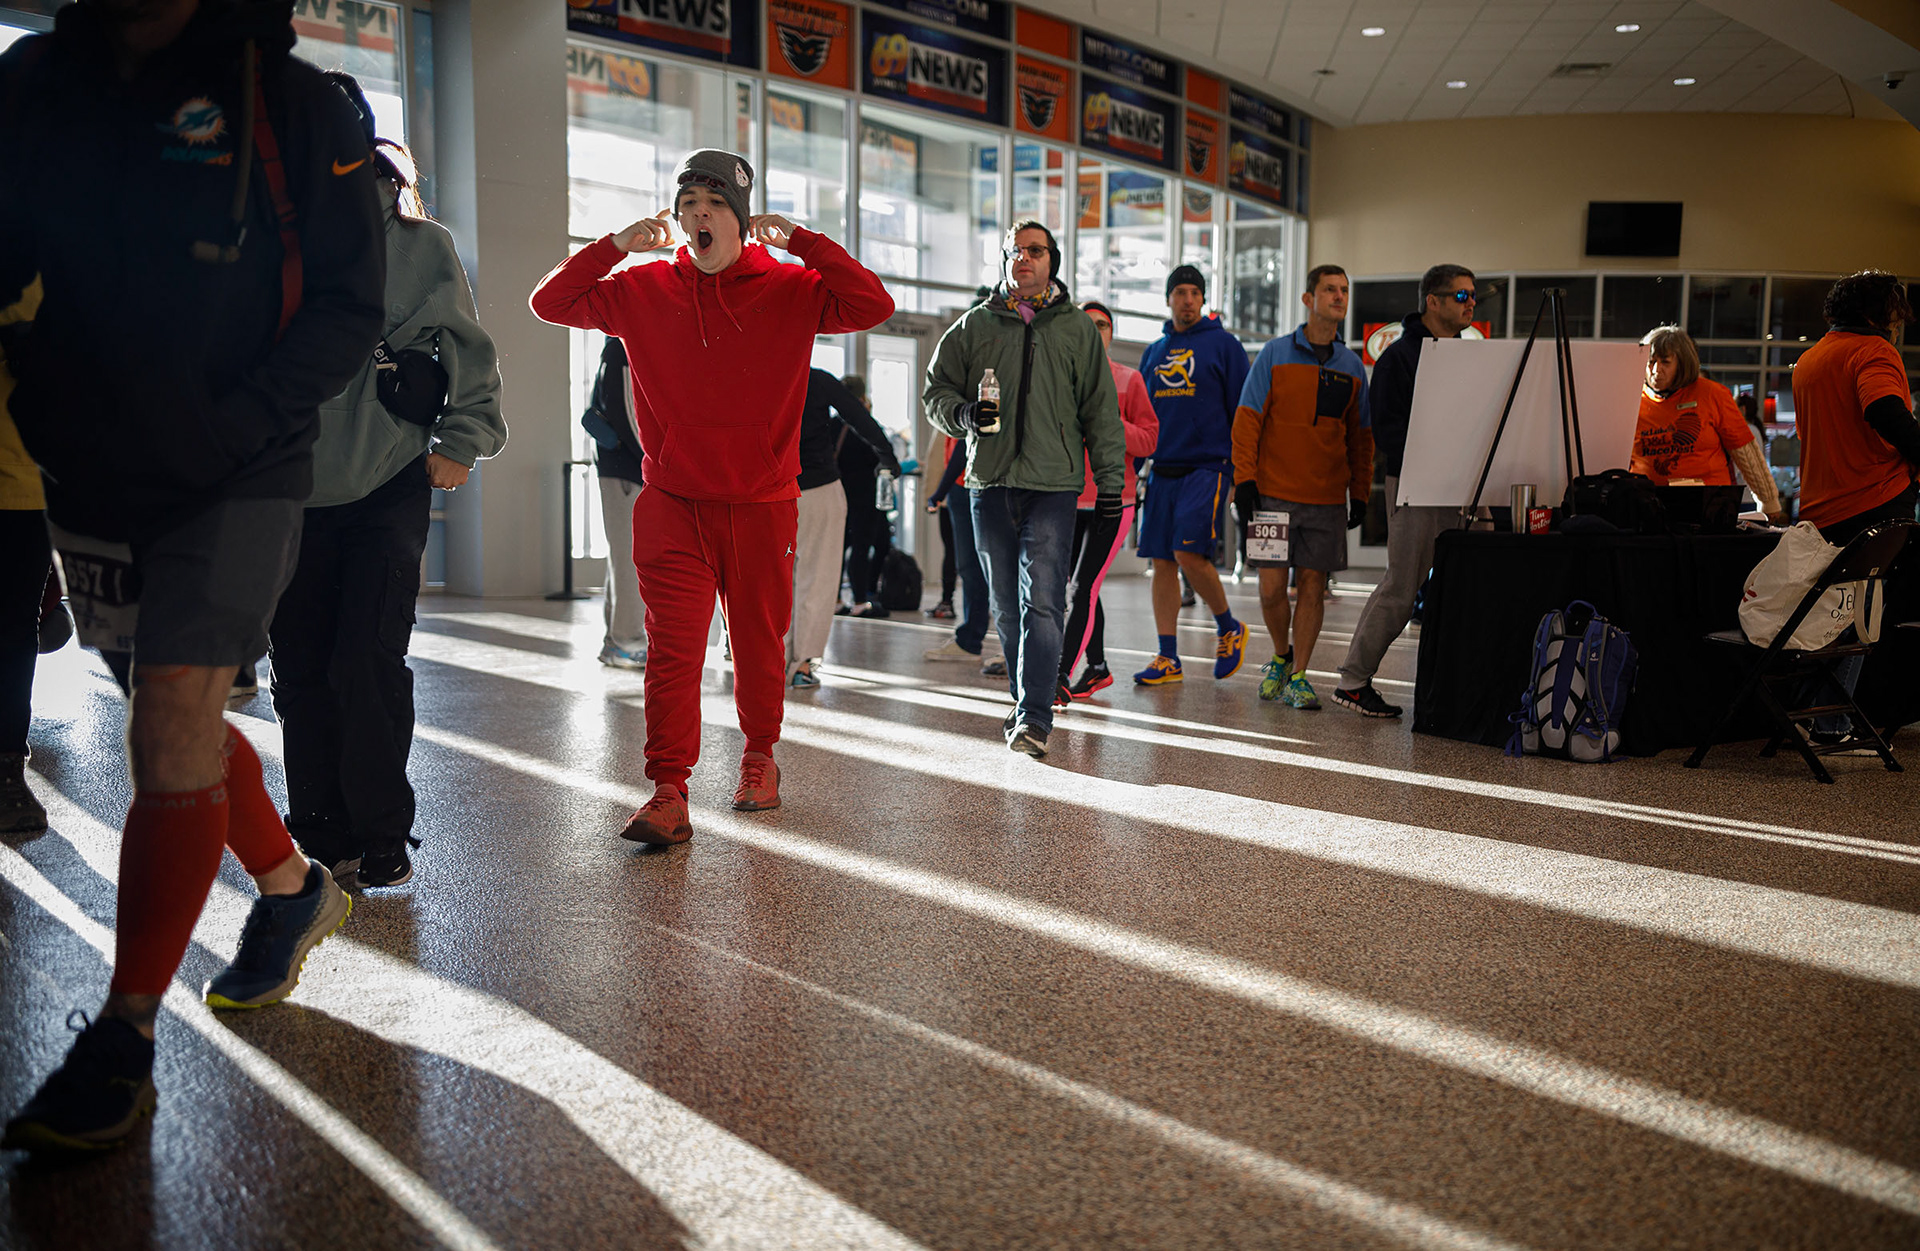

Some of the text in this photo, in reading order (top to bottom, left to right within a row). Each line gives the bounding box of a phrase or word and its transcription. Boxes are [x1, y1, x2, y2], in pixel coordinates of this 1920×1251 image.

[621, 0, 727, 33] WS
[870, 33, 908, 78] 69
[911, 45, 984, 95] NEWS
[1083, 91, 1110, 131] 69
[1112, 105, 1161, 144] NEWS
[1247, 150, 1279, 186] NEWS
[1154, 387, 1197, 398] AWESOME
[1641, 444, 1695, 457] RaceFest
[1530, 509, 1545, 521] Tim
[1255, 524, 1278, 538] 506
[64, 554, 105, 598] 657
[1835, 587, 1854, 611] Te
